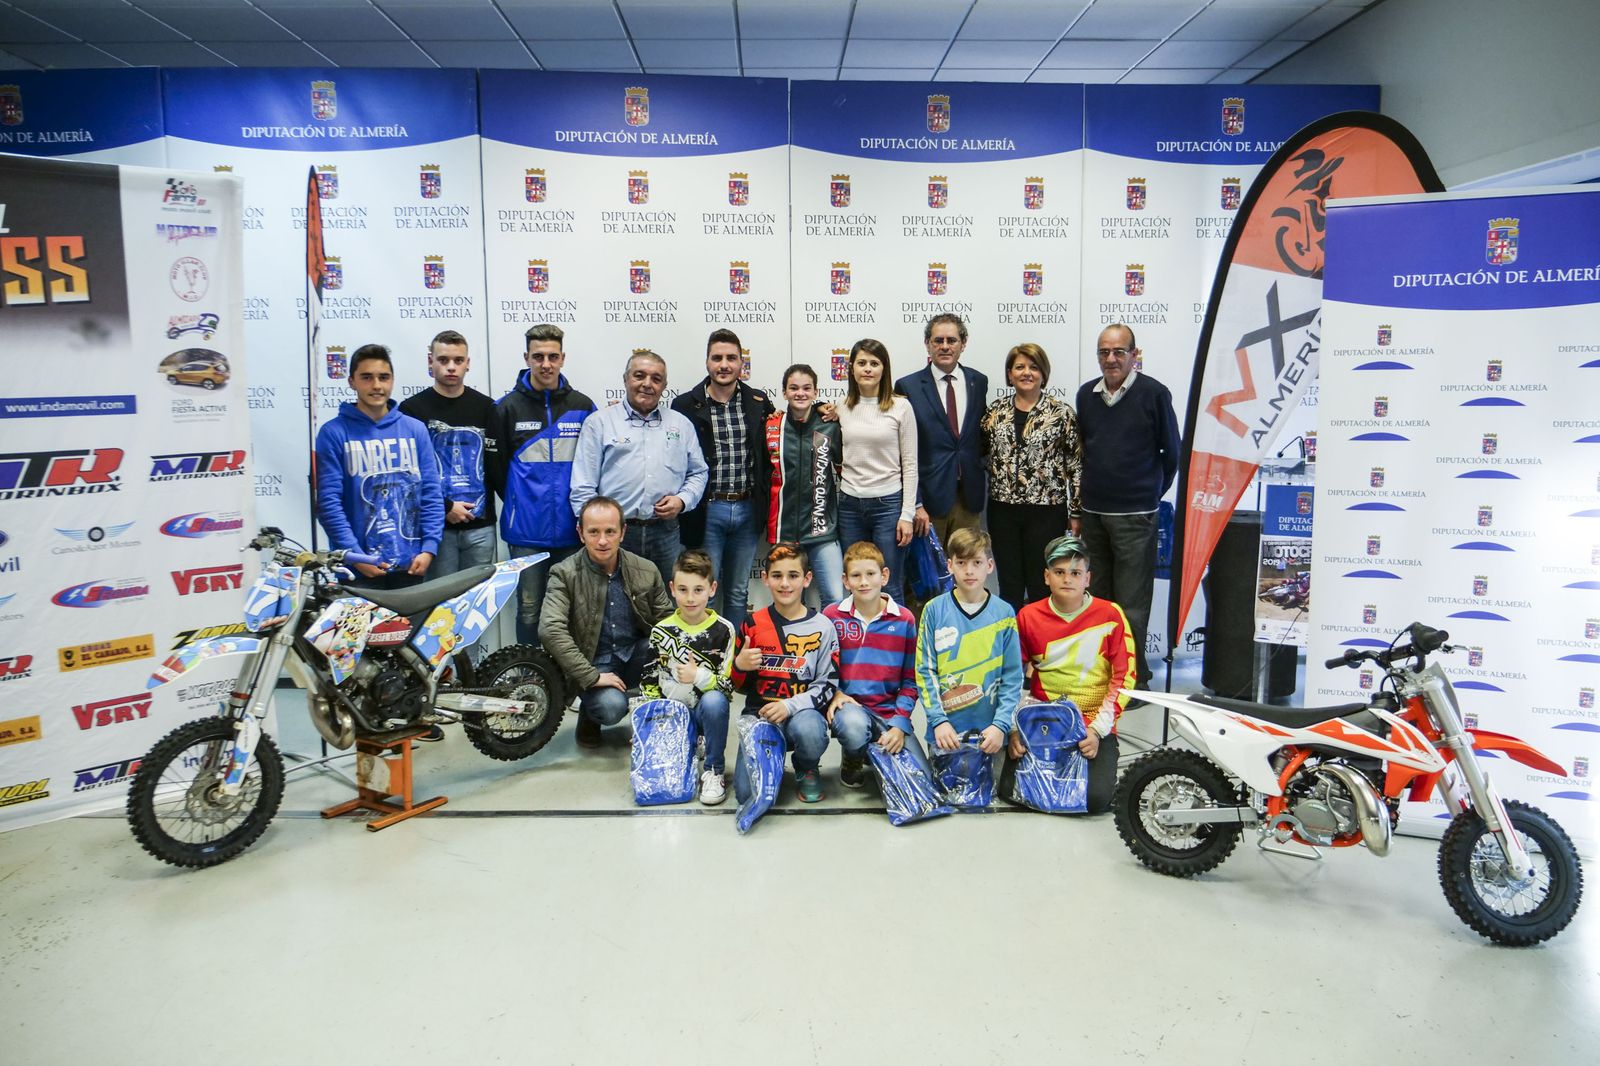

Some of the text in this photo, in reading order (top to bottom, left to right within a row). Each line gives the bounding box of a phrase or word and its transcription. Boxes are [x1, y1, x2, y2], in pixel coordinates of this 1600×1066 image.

[18, 132, 35, 143] DE
[37, 128, 94, 143] ALMERÍA
[242, 124, 408, 138] DIPUTACIÓN DE ALMERÍA
[555, 130, 718, 146] DIPUTACIÓN DE ALMERÍA
[860, 136, 1016, 151] DIPUTACIÓN DE ALMERÍA
[1156, 139, 1232, 152] DIPUTACIÓN
[1236, 142, 1251, 152] DE
[291, 206, 368, 217] DITACIÓN
[394, 204, 470, 216] DIPUTACIÓN
[498, 208, 575, 220] DIPUTACIÓN
[602, 210, 676, 222] DIPUTACIÓN
[322, 218, 368, 229] LMERÍA
[396, 217, 469, 228] DE ALMERÍA
[702, 212, 776, 224] DIPUTACIÓN
[804, 213, 876, 225] DIPUTACIÓN
[902, 214, 974, 226] DIPUTACIÓN
[998, 215, 1069, 227] DIPUTACIÓN
[1101, 216, 1171, 227] DIPUTACIÓN
[500, 220, 574, 232] DE ALMERÍA
[603, 222, 675, 234] DE ALMERÍA
[704, 223, 774, 235] DE ALMERÍA
[806, 224, 875, 237] DE ALMERÍA
[904, 226, 972, 238] DE ALMERÍA
[1000, 226, 1067, 238] DE ALMERÍA
[1102, 227, 1170, 238] DE ALMERÍA
[1196, 229, 1210, 238] DE
[1394, 264, 1600, 288] DIPUTACIÓN DE ALMERÍ
[398, 295, 472, 306] DIPUTACIÓN
[501, 299, 577, 311] DIPUTACIÓN
[604, 299, 678, 312] DIPUTACIÓN
[704, 300, 776, 312] DIPUTACIÓN
[805, 300, 876, 312] DIPUTACIÓN
[902, 300, 972, 312] DIPUTACIÓN
[998, 301, 1068, 312] DIPUTACIÓN
[400, 307, 472, 318] DE ALMERÍA
[1100, 302, 1168, 312] DIPUTACIÓN
[503, 310, 576, 322] DE ALMERÍA
[605, 310, 676, 322] DE ALMERÍA
[705, 311, 775, 323] DE ALMERÍA
[806, 311, 875, 323] DE ALMERÍA
[903, 314, 918, 323] DE
[999, 312, 1066, 324] DE ALMERÍA
[1101, 313, 1166, 324] DE ALMERÍA
[1334, 348, 1382, 356] DIPUTACIÓN
[1251, 319, 1321, 449] ALMERÍ
[1440, 384, 1492, 392] DIPUTACIÓN
[6, 400, 124, 412] www.indamovil.com
[1330, 418, 1380, 427] DIPUTACIÓN
[344, 438, 421, 480] UNREAL
[1436, 456, 1488, 464] DIPUTACIÓN
[1504, 456, 1542, 464] ALMERÍA
[0, 482, 122, 500] ORINBOX
[1328, 488, 1376, 497] DIPUTACIÓN
[1391, 490, 1426, 498] ALMERÍA
[813, 488, 825, 516] MOTO
[1278, 516, 1312, 524] DIPUTAC
[1324, 556, 1372, 564] DIPUTACIÓN
[170, 564, 244, 596] VSRY
[1428, 596, 1479, 605] DIPUTACIÓN
[1495, 599, 1532, 608] ALMERÍA
[1320, 624, 1368, 633] DIPUTACIÓN
[1490, 671, 1527, 680] ALMERÍA
[1318, 688, 1366, 698] DIPUTACIÓN
[72, 692, 152, 730] VSRY
